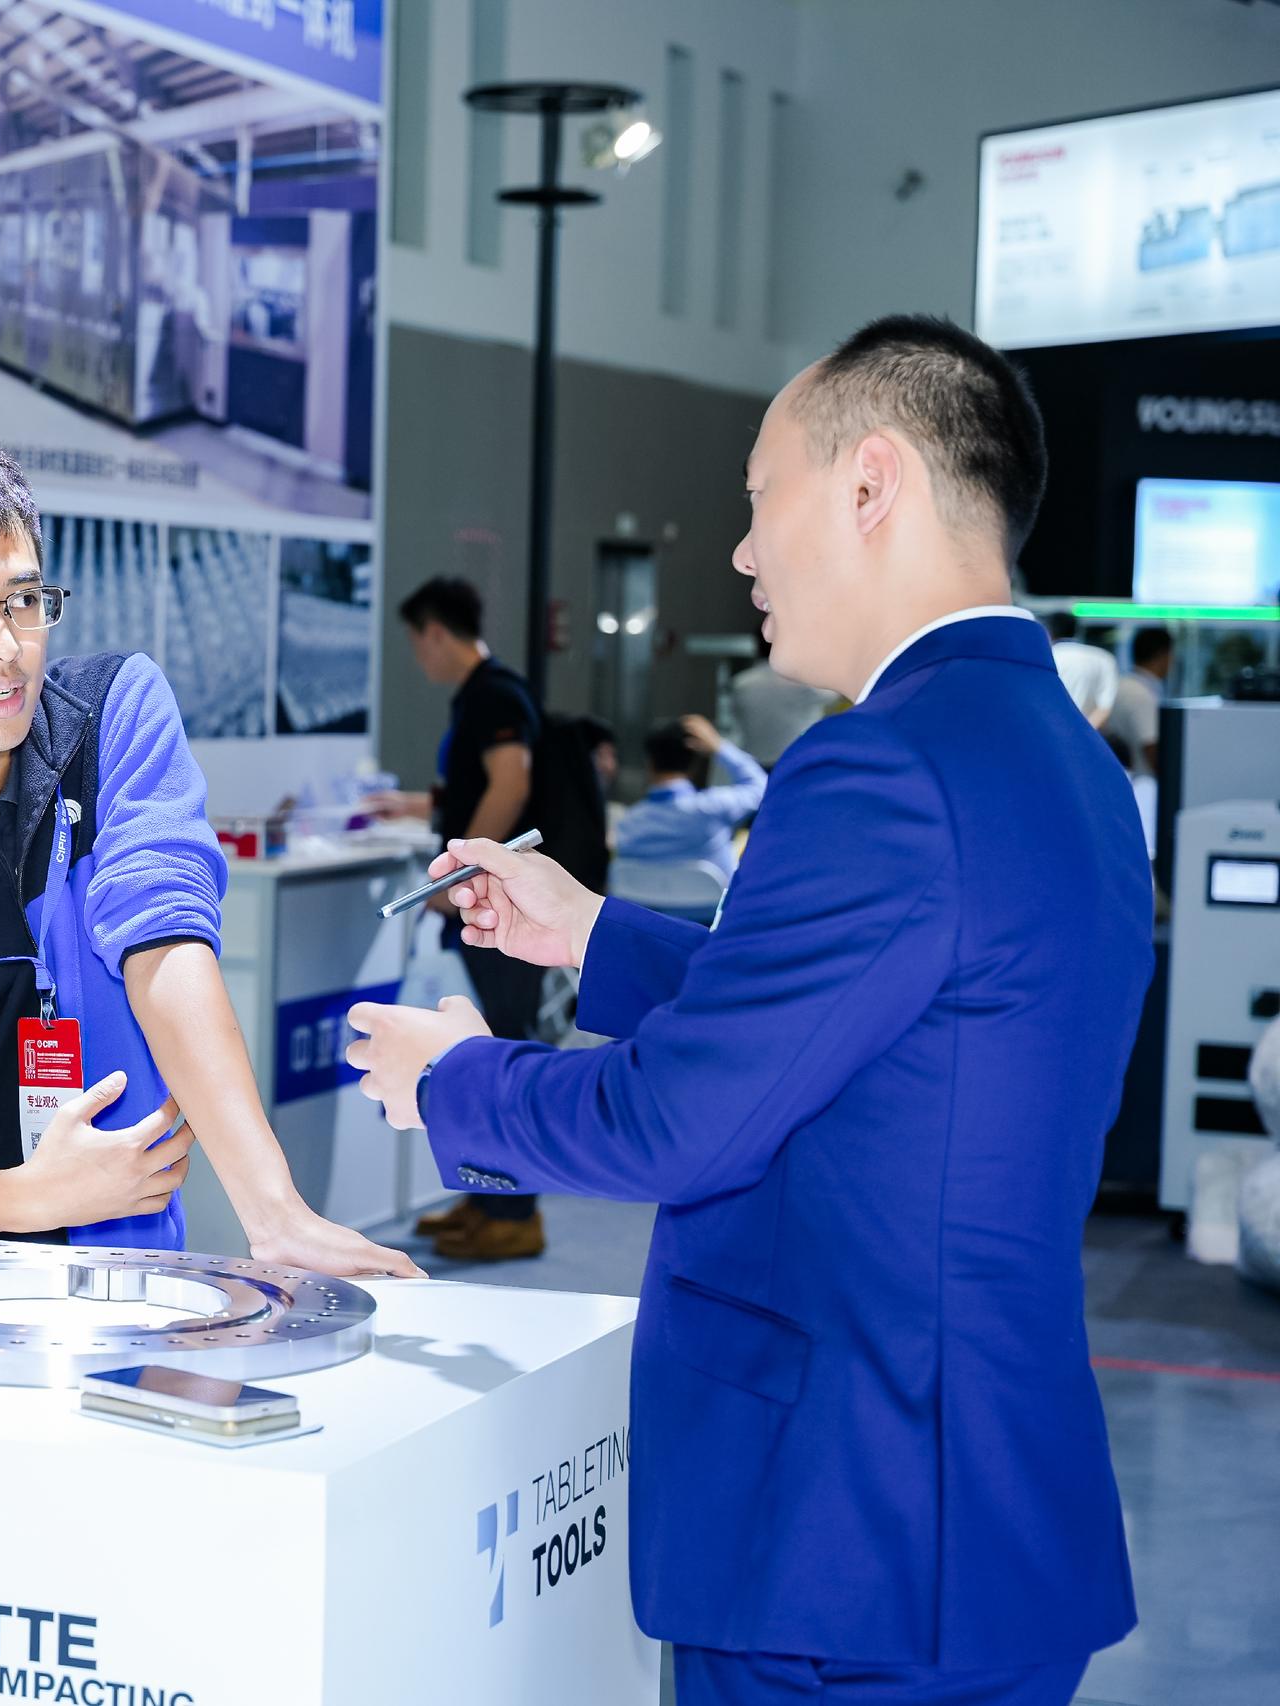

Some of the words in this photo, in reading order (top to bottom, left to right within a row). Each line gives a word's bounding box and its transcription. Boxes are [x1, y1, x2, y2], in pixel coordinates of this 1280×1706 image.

[27, 1095, 59, 1109] 专业观众
[531, 1425, 630, 1526] TABLETIN
[531, 1504, 607, 1597] TOOLS
